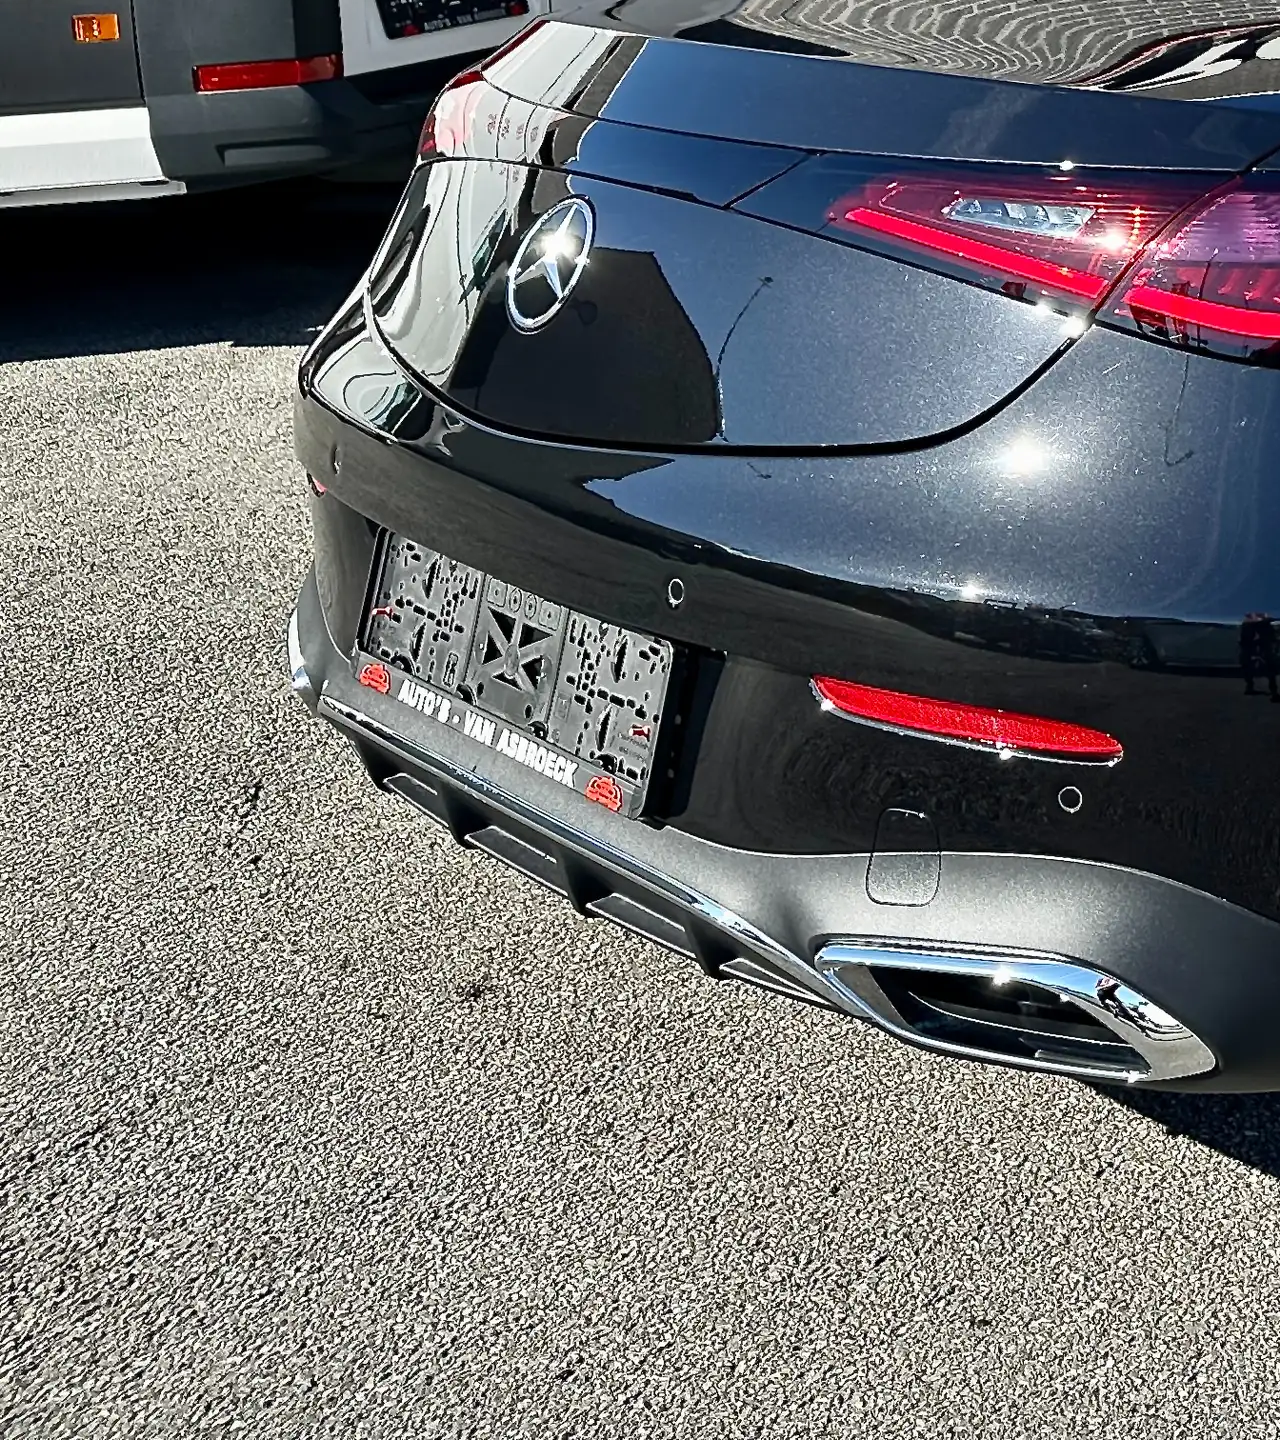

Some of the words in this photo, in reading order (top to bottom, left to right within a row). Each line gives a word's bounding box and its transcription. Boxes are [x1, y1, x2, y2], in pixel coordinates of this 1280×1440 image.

[397, 678, 452, 724] AUTO'S
[463, 709, 497, 747] VAN
[495, 727, 579, 788] ASBROECK
